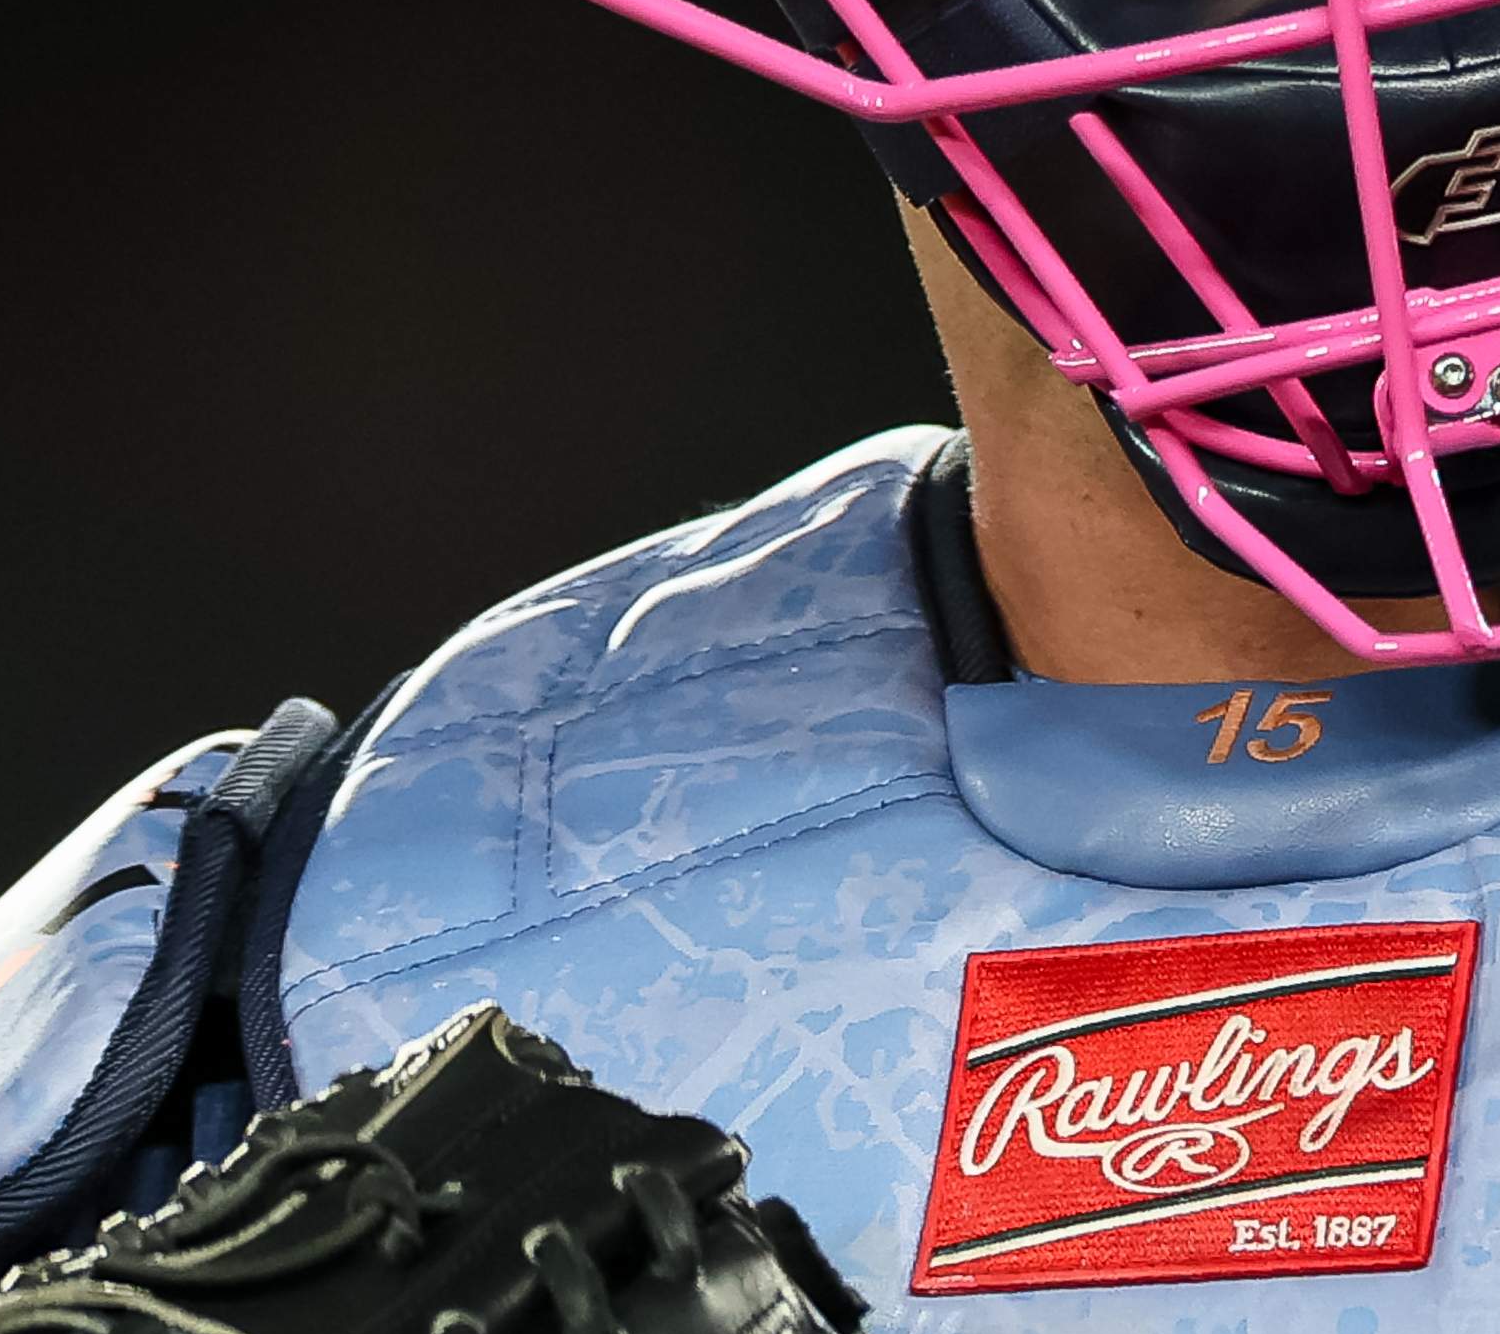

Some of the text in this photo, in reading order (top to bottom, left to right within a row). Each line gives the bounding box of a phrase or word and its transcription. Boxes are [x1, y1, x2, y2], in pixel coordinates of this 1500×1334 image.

[1195, 688, 1334, 764] 15
[959, 1013, 1436, 1177] Rawlings
[1228, 1214, 1397, 1253] Est. 1887
